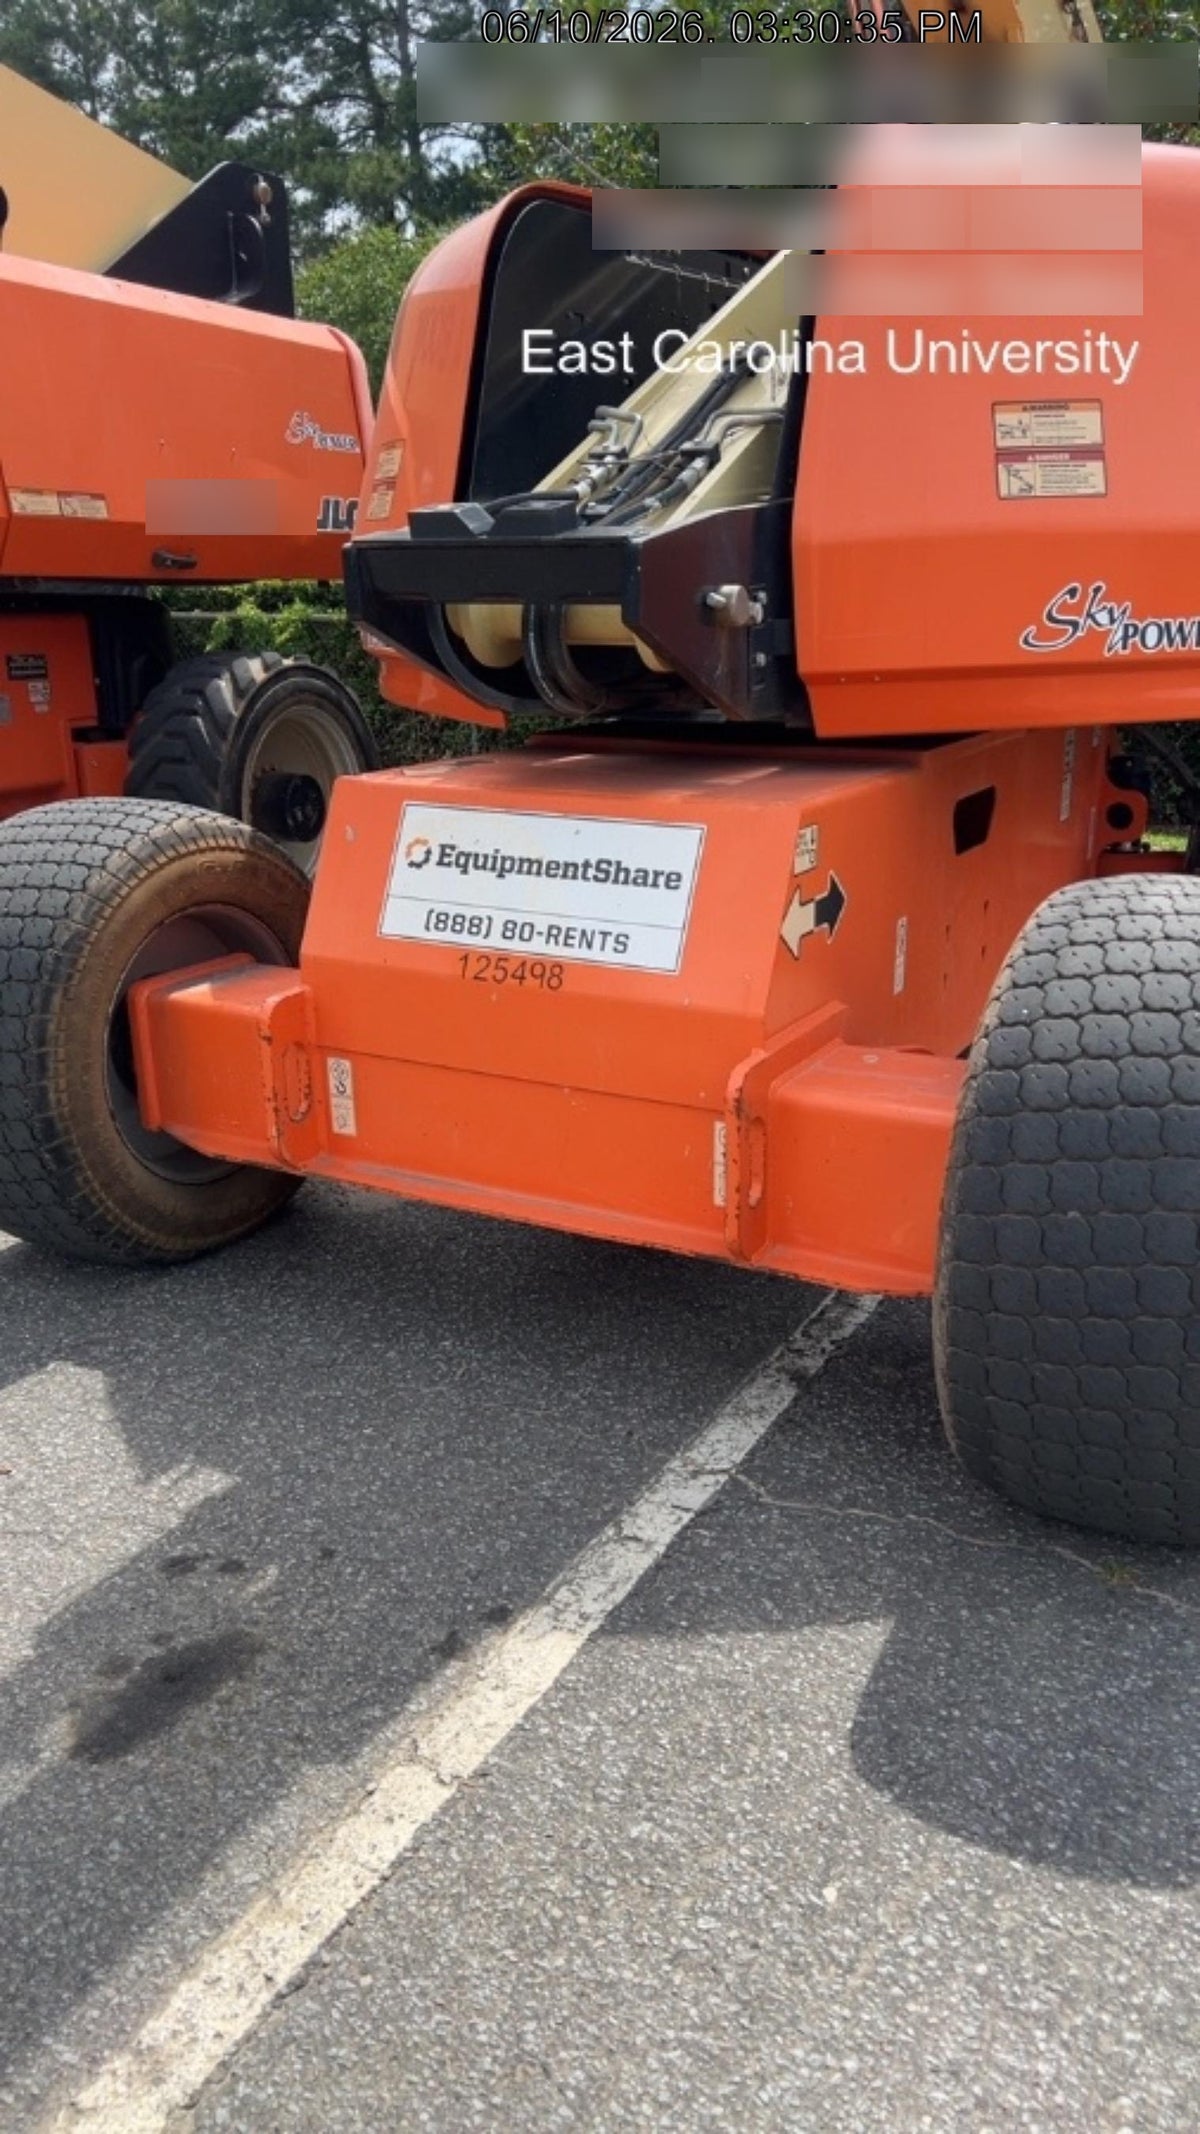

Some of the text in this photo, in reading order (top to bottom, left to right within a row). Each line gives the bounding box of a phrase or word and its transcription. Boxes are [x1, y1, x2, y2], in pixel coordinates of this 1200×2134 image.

[436, 843, 682, 890] EquipmentShare
[424, 909, 630, 954] (888) 80-RENTS
[458, 954, 565, 991] 125498
